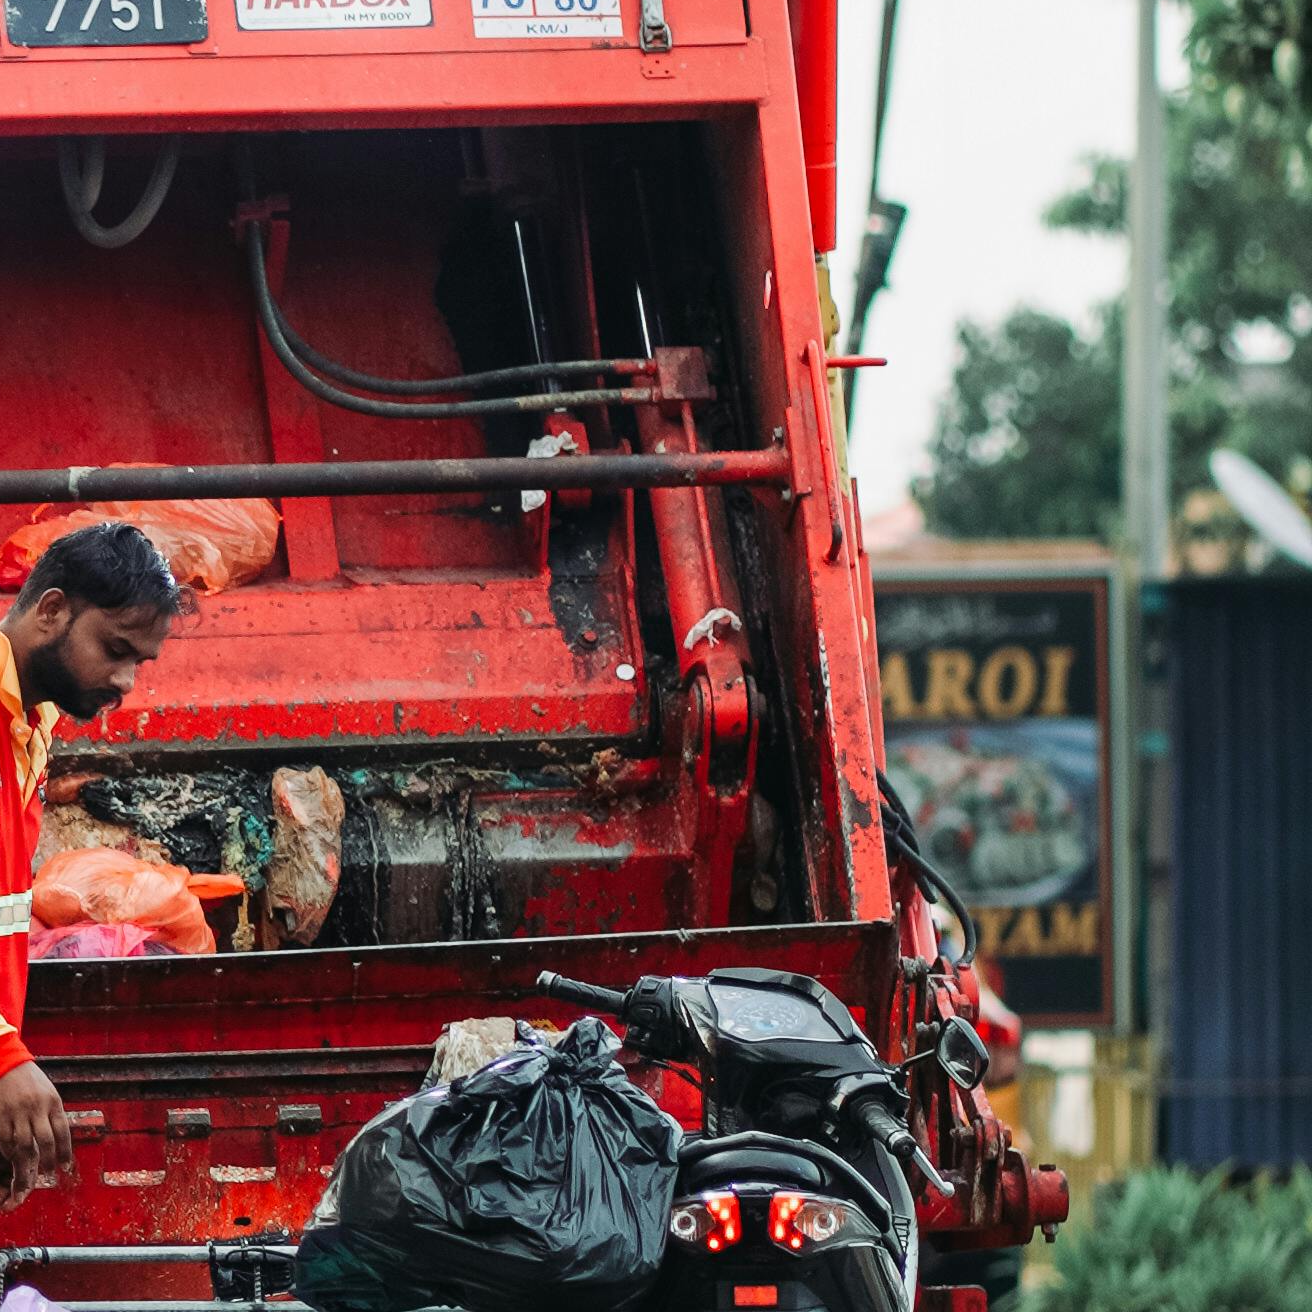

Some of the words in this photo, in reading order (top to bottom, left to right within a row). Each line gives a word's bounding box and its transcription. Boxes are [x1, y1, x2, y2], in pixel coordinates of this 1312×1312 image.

[344, 13, 356, 22] IN
[358, 12, 377, 22] MY
[380, 11, 412, 22] BODY
[526, 23, 569, 36] KM/J
